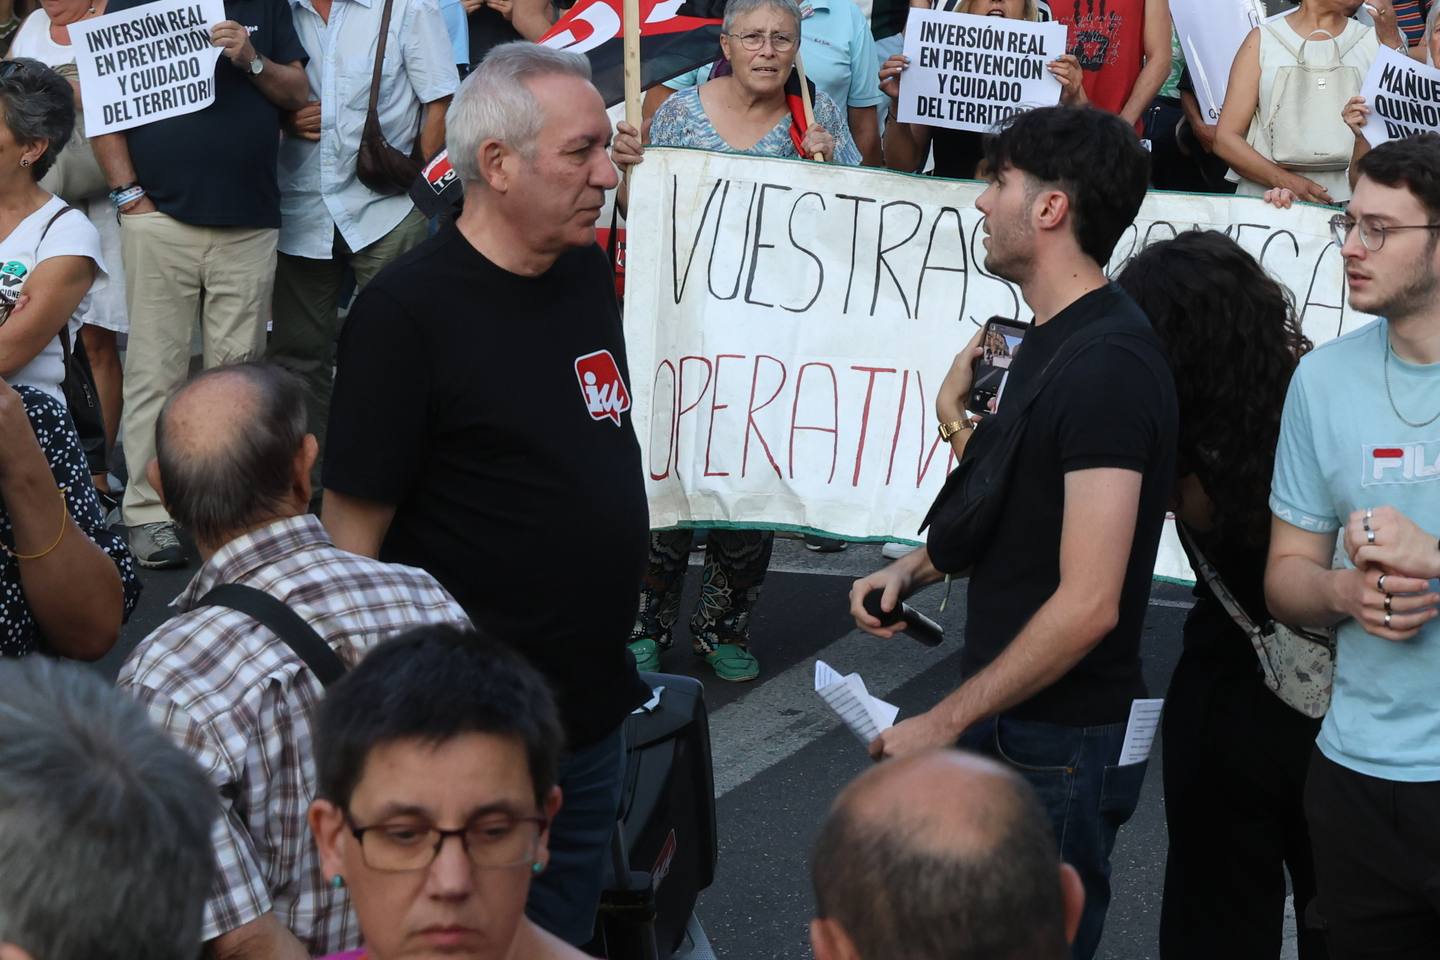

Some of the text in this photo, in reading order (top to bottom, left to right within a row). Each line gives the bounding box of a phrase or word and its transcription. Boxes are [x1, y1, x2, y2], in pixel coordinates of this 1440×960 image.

[86, 4, 207, 53] INVERSIÓN REAL
[920, 21, 1005, 52] INVERSIÓN
[1007, 31, 1047, 56] REAL
[95, 28, 212, 77] EN PREVENCIÓN
[920, 46, 1043, 80] EN PREVENCIÓN
[117, 57, 201, 96] Y CUIDADO
[937, 73, 1022, 103] Y CUIDADO
[103, 78, 214, 126] DEL TERRITORI
[916, 95, 944, 119] DEL
[673, 174, 1020, 328] VUESTRAS
[650, 354, 956, 489] OPERATIV
